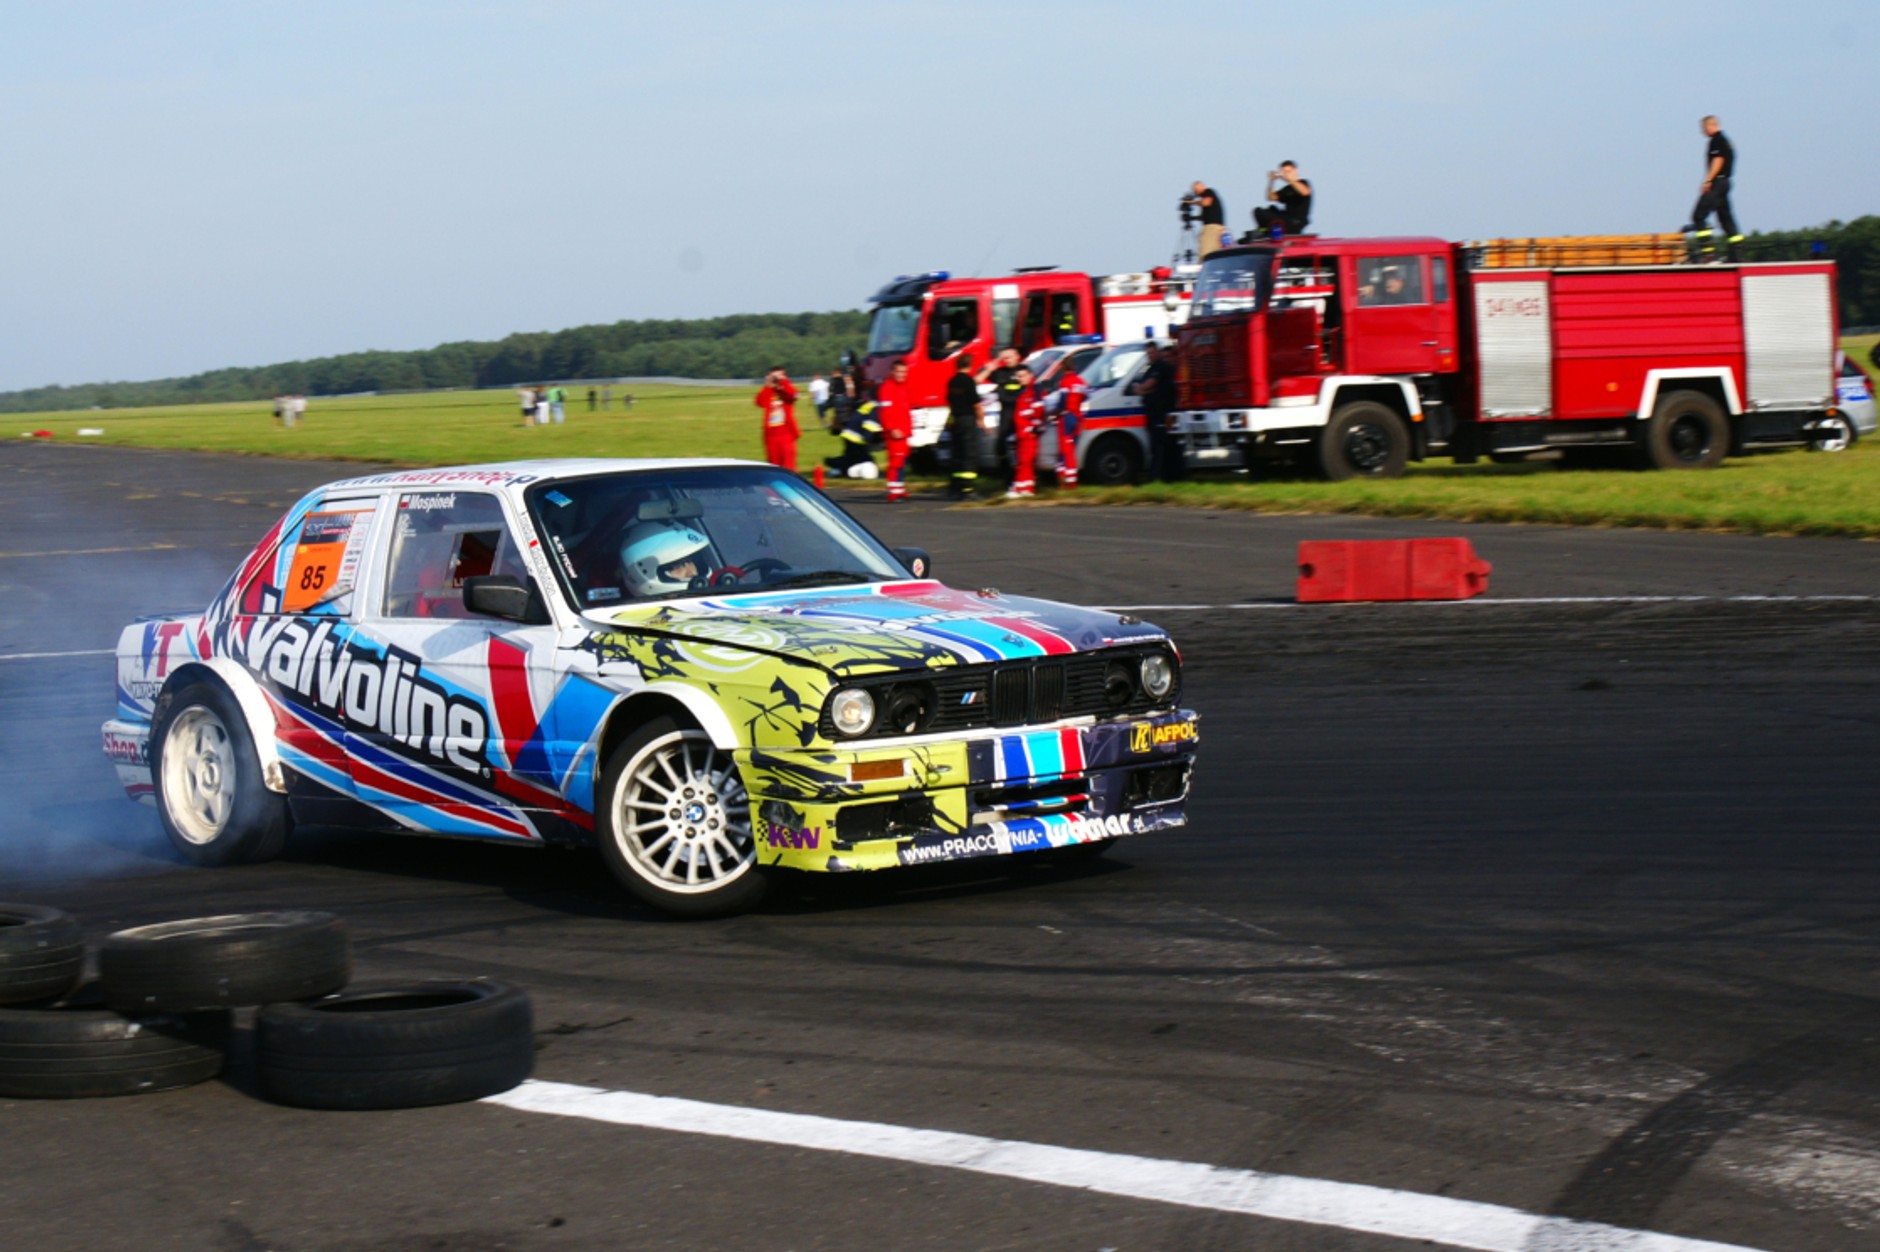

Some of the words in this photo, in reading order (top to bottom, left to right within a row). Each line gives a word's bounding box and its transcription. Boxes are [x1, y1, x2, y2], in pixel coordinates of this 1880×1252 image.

[300, 565, 327, 591] 85
[247, 592, 488, 775] Valvoline
[768, 822, 821, 850] KW
